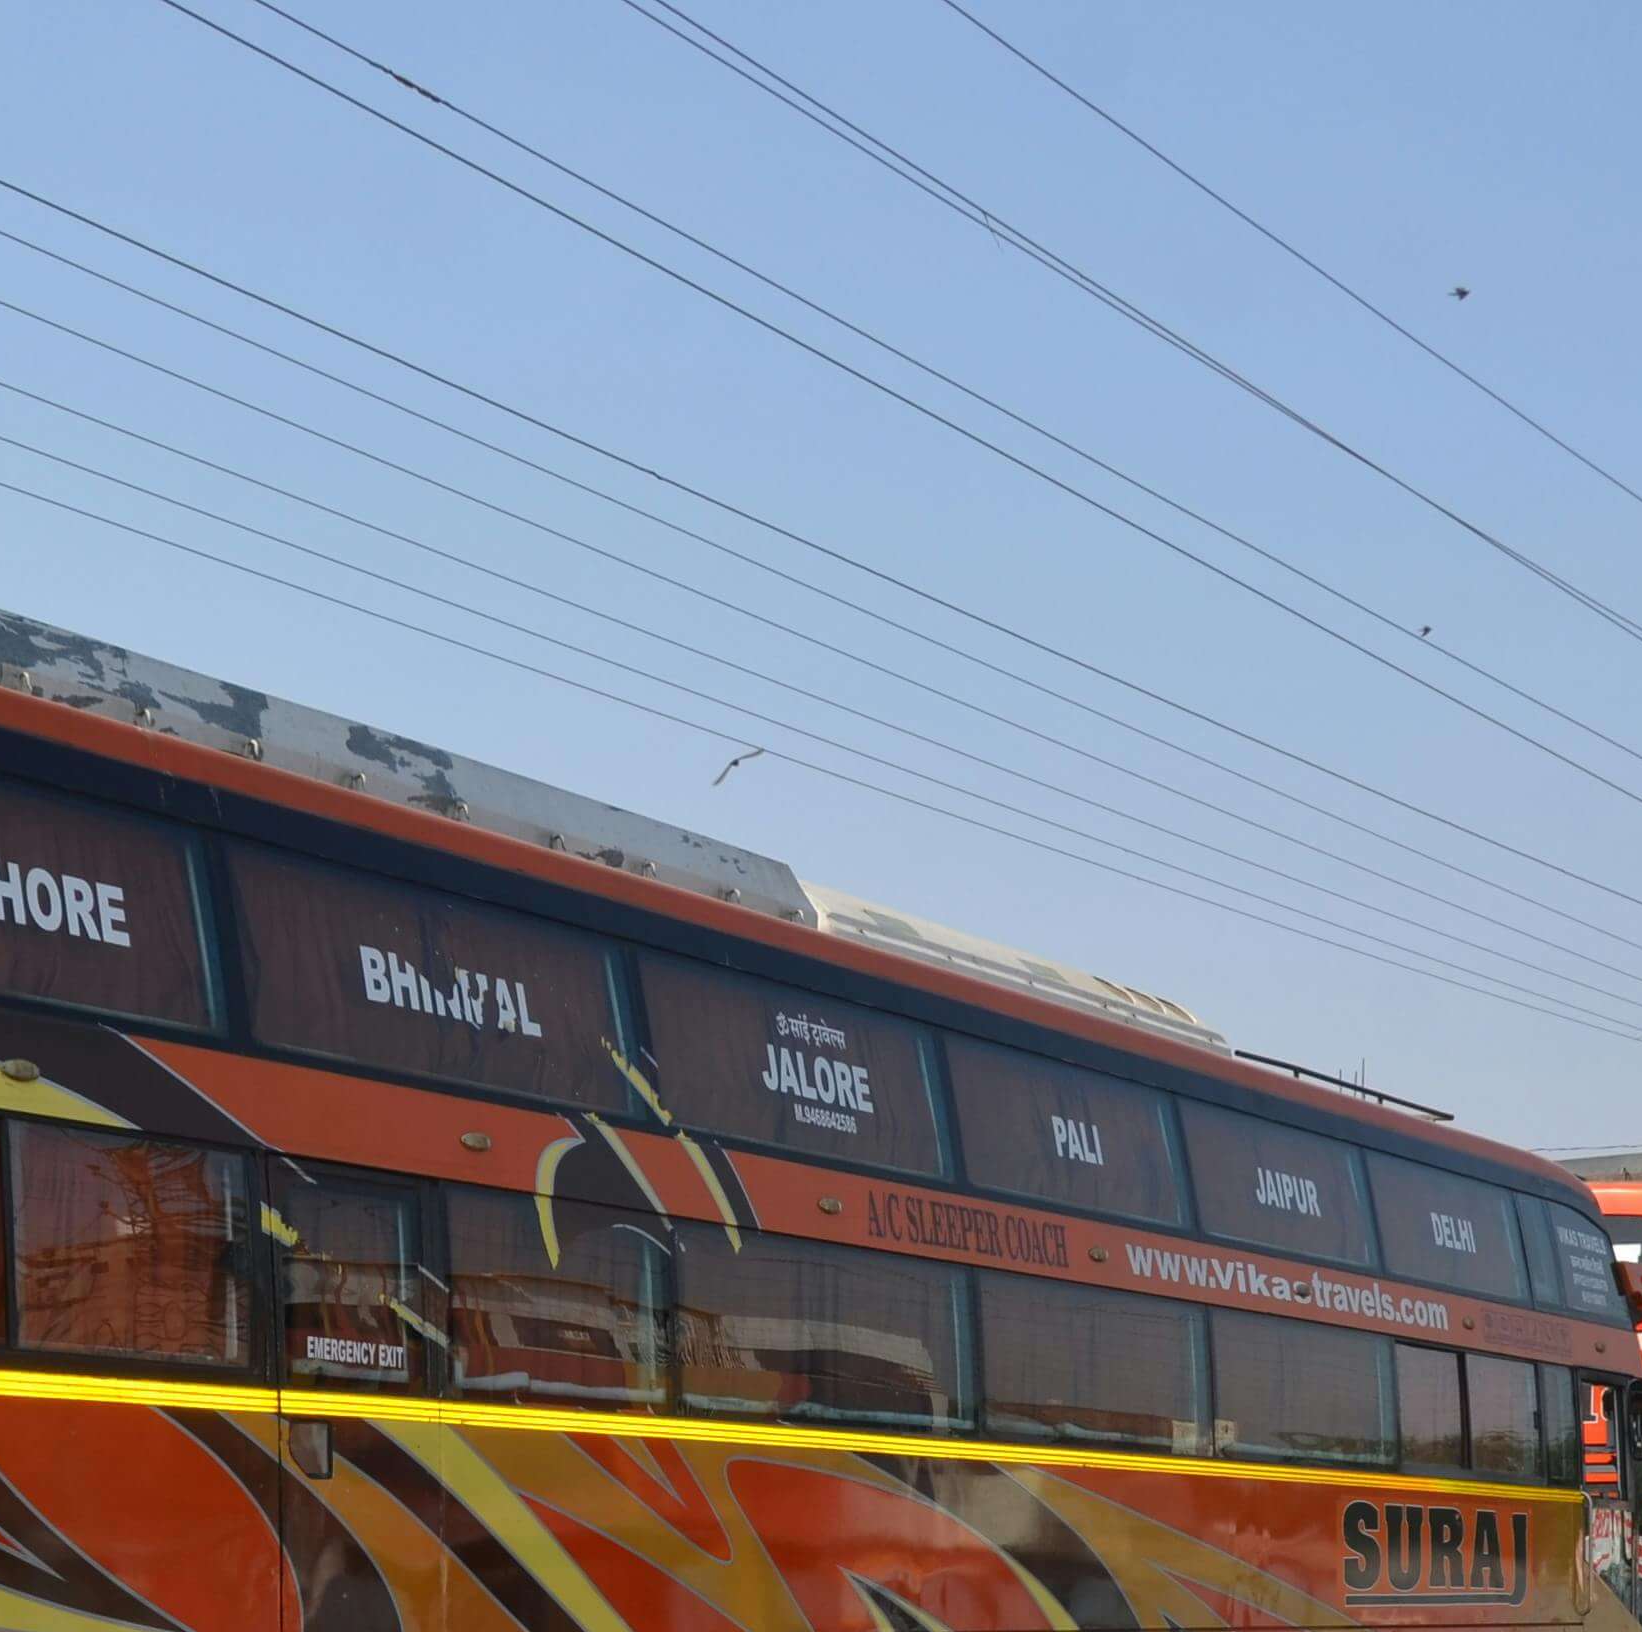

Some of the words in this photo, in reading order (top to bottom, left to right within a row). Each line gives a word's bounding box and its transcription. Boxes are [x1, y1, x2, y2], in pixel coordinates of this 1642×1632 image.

[762, 1043, 874, 1113] JALORE
[1051, 1115, 1104, 1166] PALI
[1256, 1167, 1322, 1217] JAIPUR
[868, 1190, 903, 1241] A/C
[906, 1196, 1003, 1258] SLEEPER
[1005, 1215, 1070, 1268] COACH
[1429, 1212, 1477, 1254] DELHI
[307, 1336, 376, 1366] EMERGENCY
[378, 1344, 405, 1369] EXIT
[1343, 1500, 1529, 1607] SURAJ
